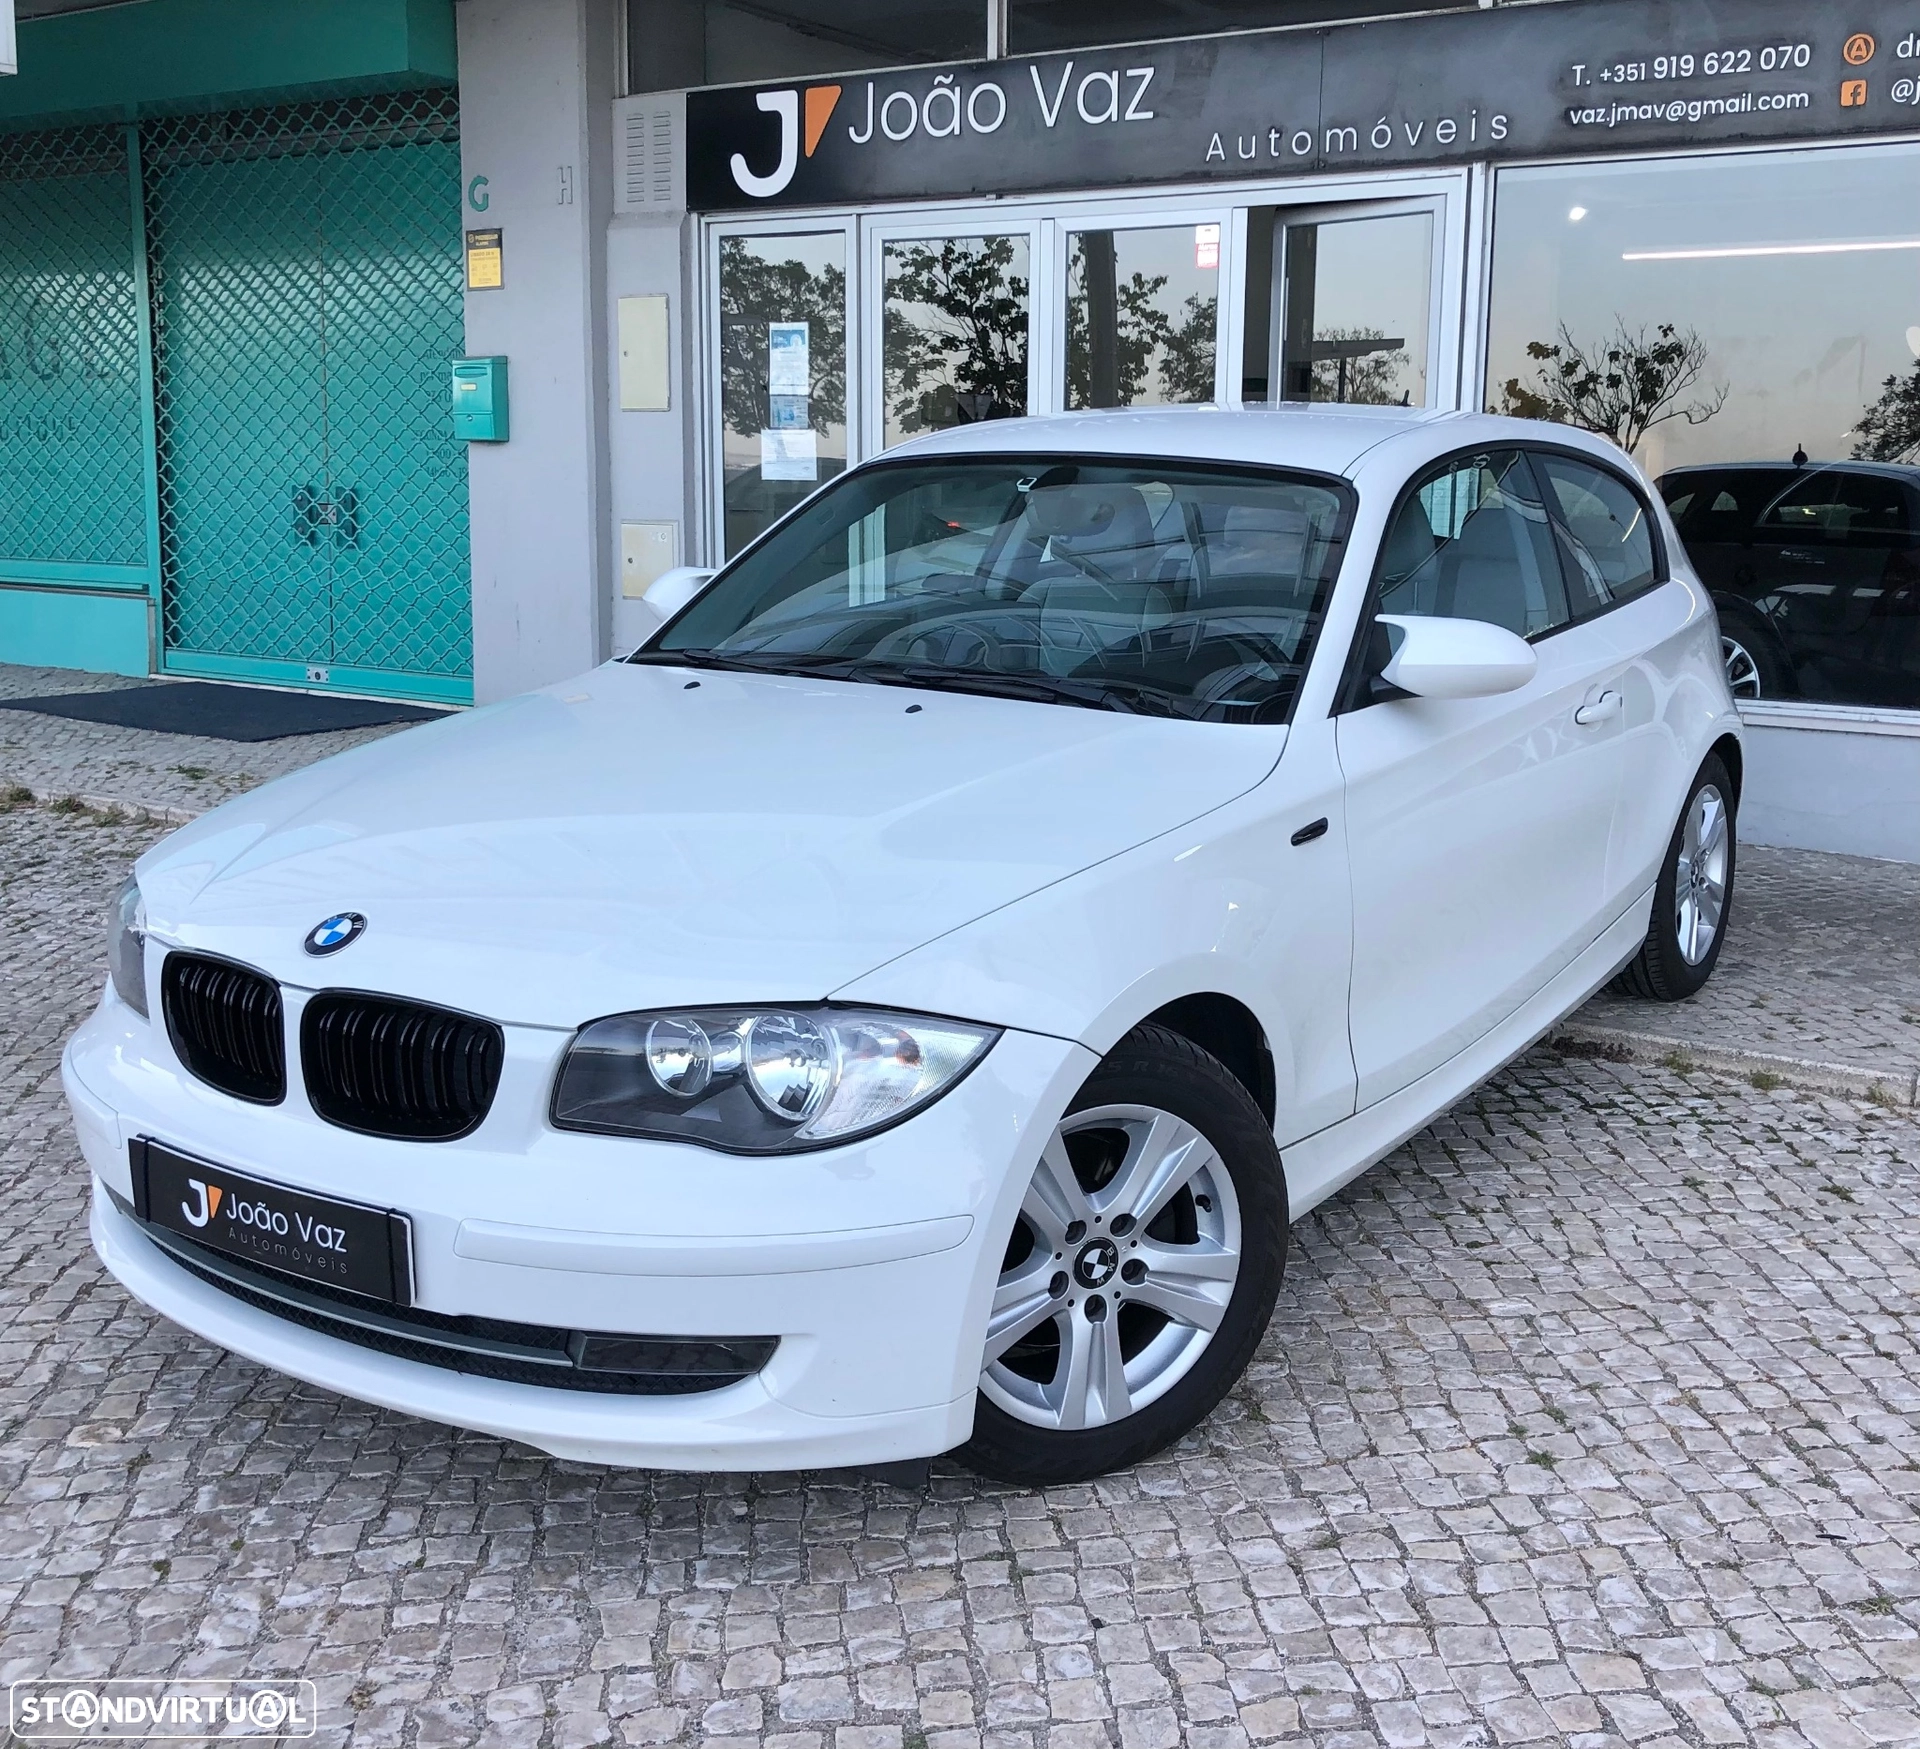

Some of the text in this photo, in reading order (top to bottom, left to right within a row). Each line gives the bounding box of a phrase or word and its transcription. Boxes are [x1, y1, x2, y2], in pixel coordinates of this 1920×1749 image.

[1571, 43, 1811, 86] T. +351 919 622 070
[847, 60, 1156, 145] João Vaz
[1570, 91, 1810, 128] vaz.jmav@gmail.com
[1205, 108, 1509, 163] Automóveis
[468, 175, 489, 213] G
[226, 1192, 348, 1253] João Vaz
[227, 1226, 348, 1275] Automóveis
